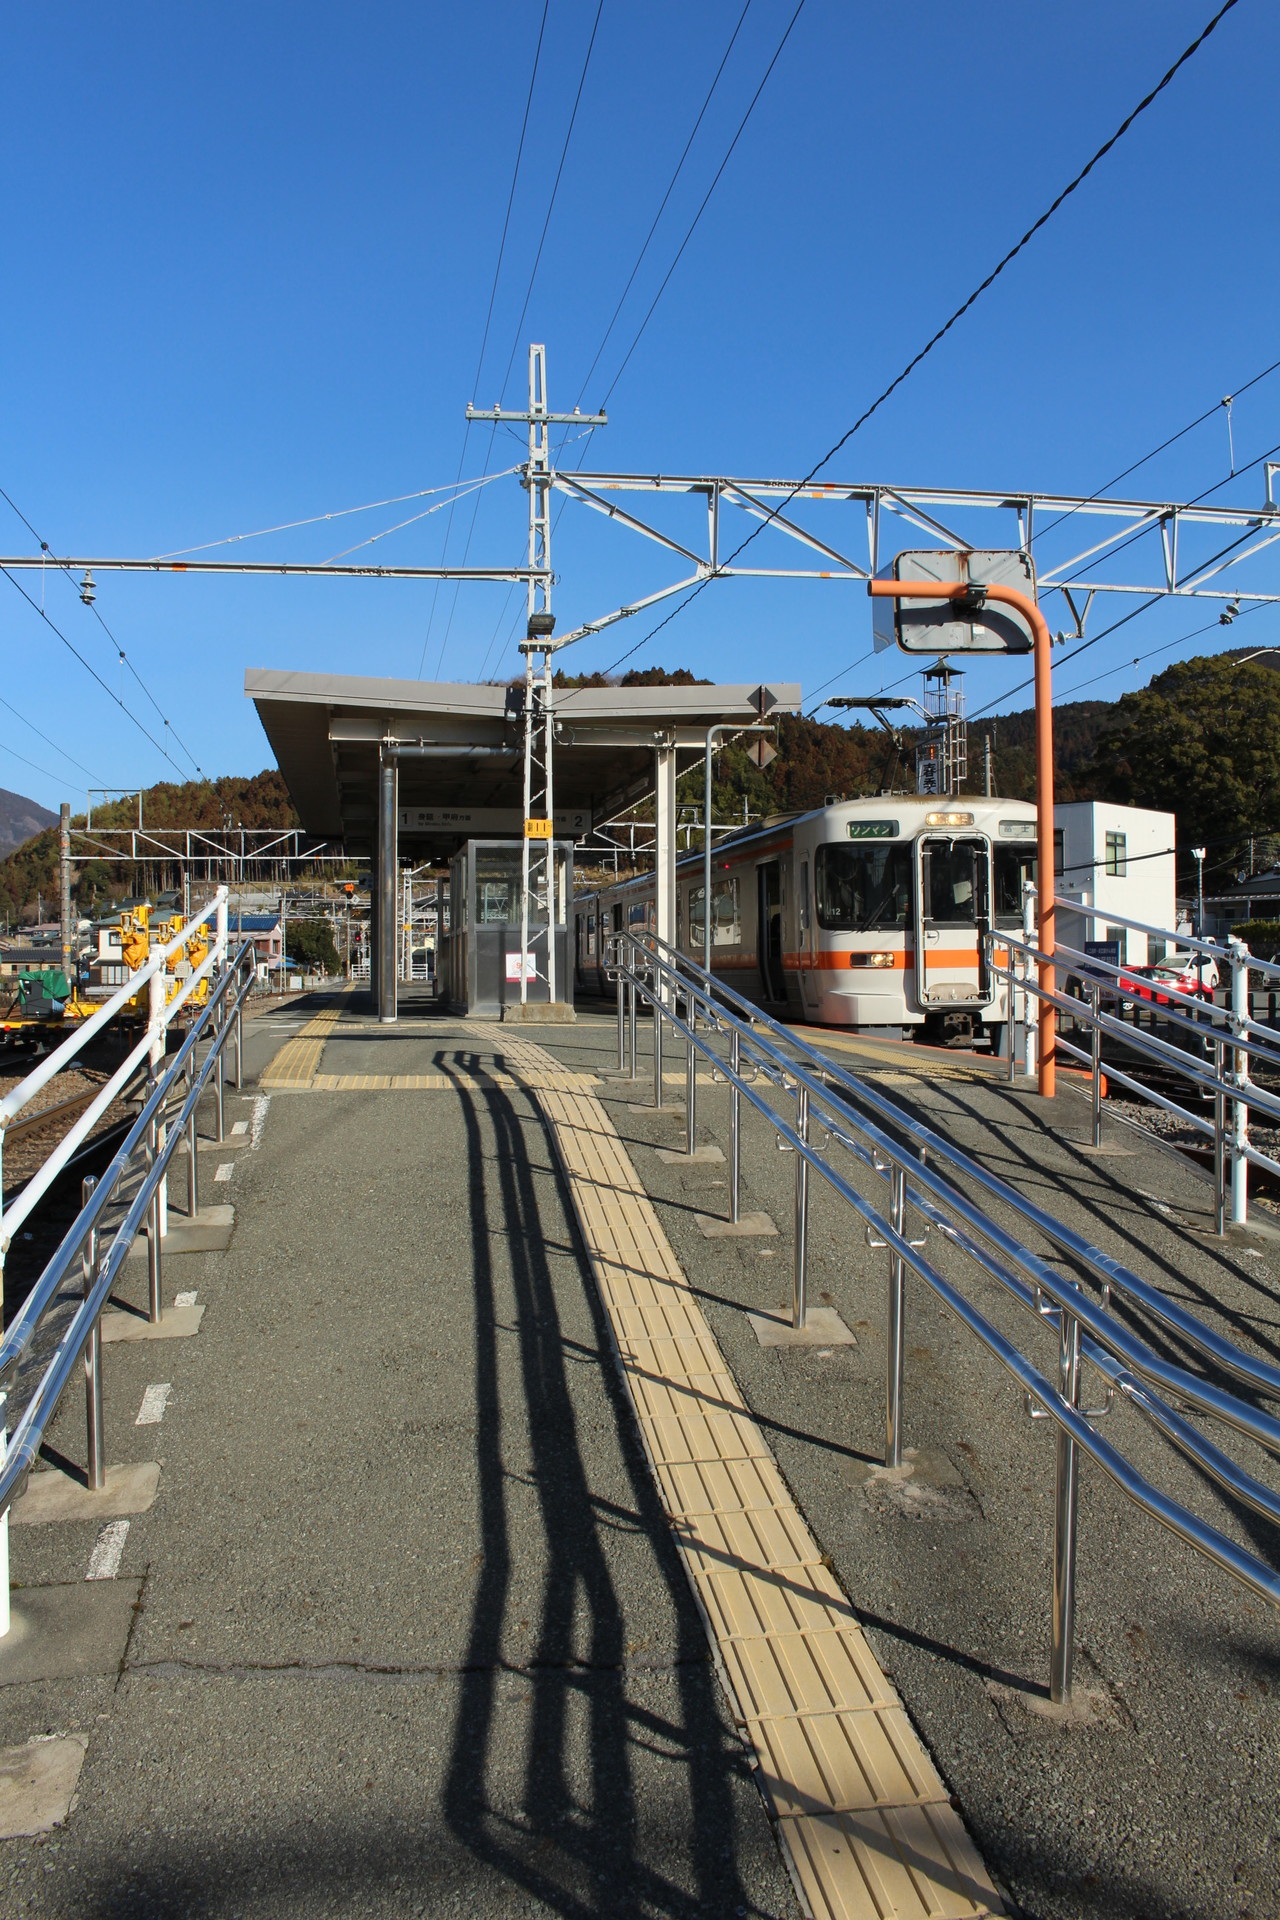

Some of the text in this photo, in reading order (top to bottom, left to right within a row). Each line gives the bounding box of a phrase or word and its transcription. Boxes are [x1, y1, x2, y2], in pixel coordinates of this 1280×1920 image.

[401, 812, 408, 824] 1
[574, 815, 583, 827] 2
[851, 823, 890, 835] ワンマン
